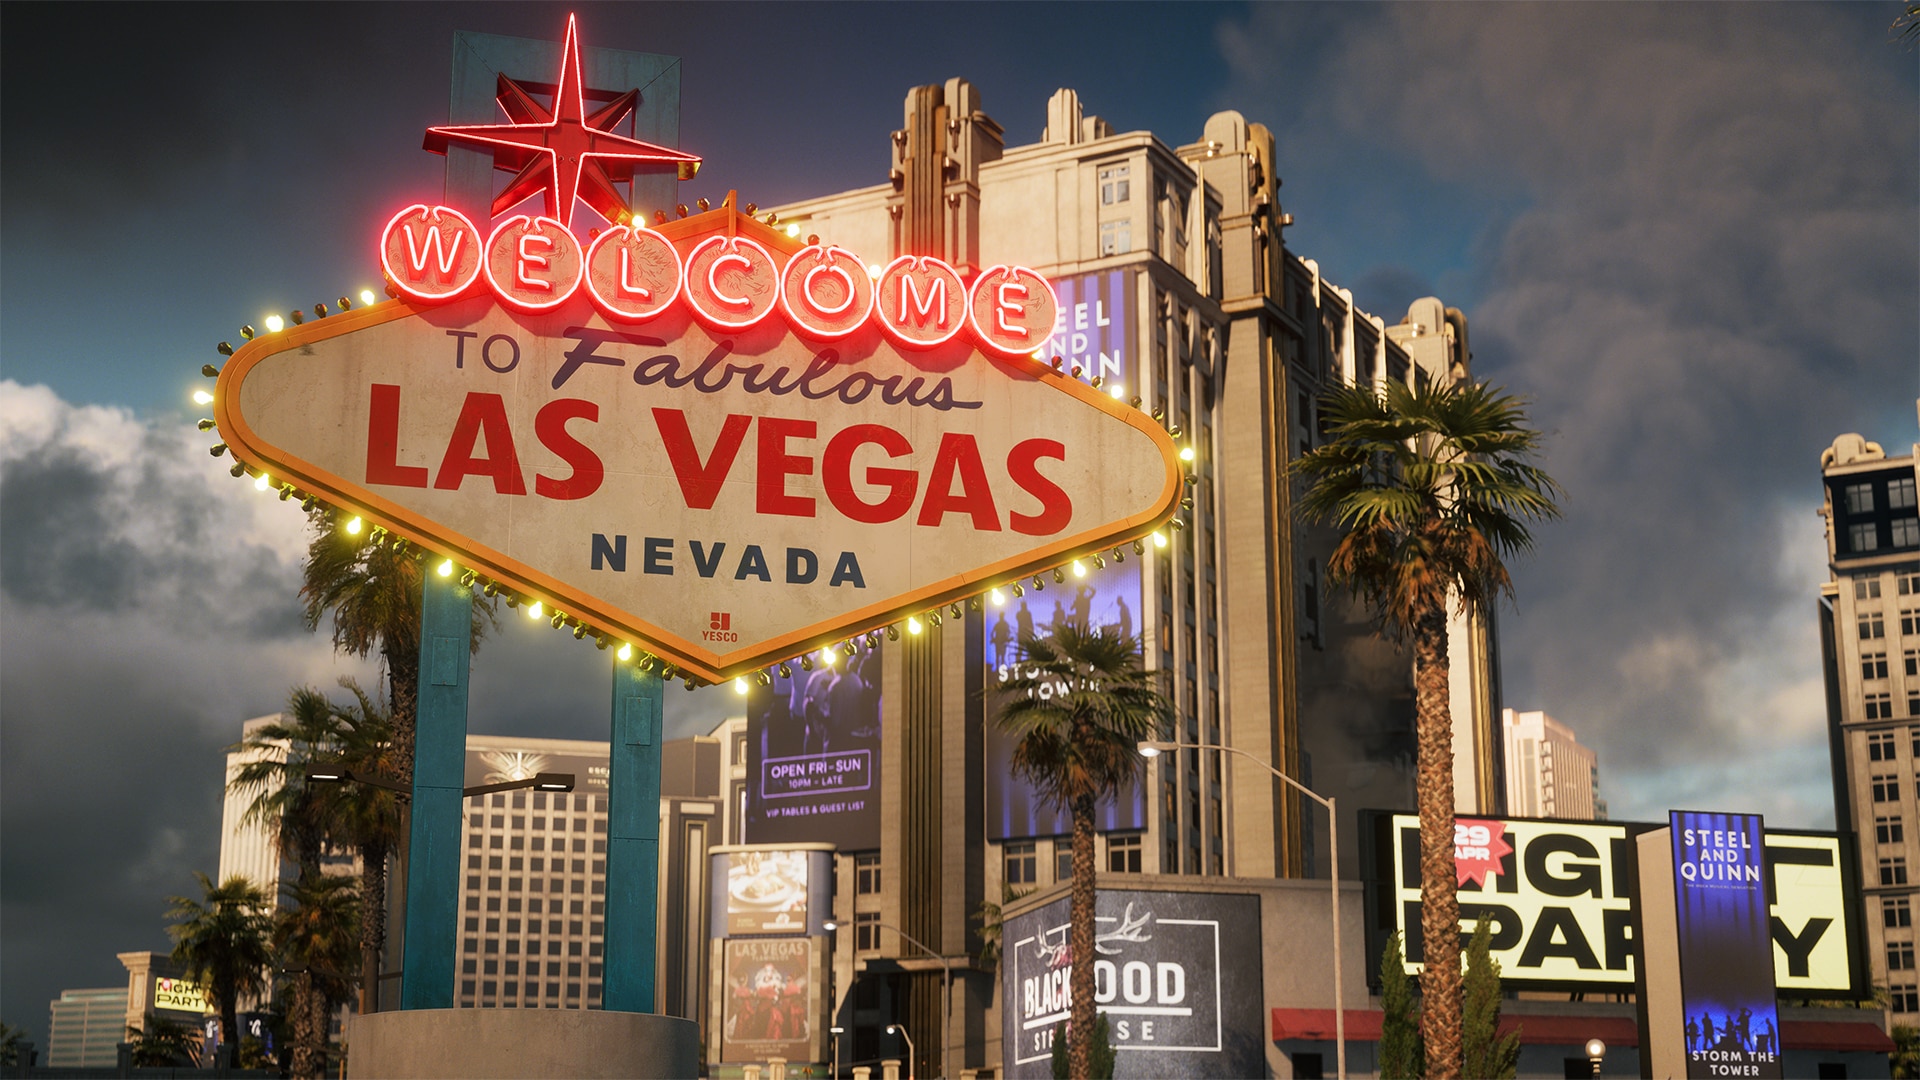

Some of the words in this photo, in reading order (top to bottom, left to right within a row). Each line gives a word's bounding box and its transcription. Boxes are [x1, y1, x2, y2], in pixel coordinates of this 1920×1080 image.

[398, 222, 1030, 338] WELCOME
[1054, 300, 1110, 334] EEL
[446, 330, 520, 373] TO
[551, 326, 983, 411] Fabulous
[365, 383, 605, 501] LAS
[651, 407, 1073, 537] VEGAS
[590, 533, 867, 588] NEVADA
[702, 630, 738, 643] YESCO
[771, 763, 805, 779] OPEN
[789, 778, 811, 789] 10PM
[822, 775, 843, 786] LATE
[766, 808, 779, 818] VIP
[782, 805, 810, 817] TABLES
[820, 802, 846, 814] GUEST
[848, 800, 865, 811] LIST
[1453, 824, 1491, 846] 29
[1684, 828, 1751, 849] STEEL
[1454, 846, 1490, 861] APR
[1700, 848, 1739, 863] AND
[1680, 862, 1760, 882] QUINN
[735, 942, 757, 956] LAS
[761, 942, 804, 956] VEGAS
[1692, 1050, 1742, 1062] STORM
[1748, 1051, 1775, 1063] THE
[1709, 1064, 1760, 1077] TOWER
